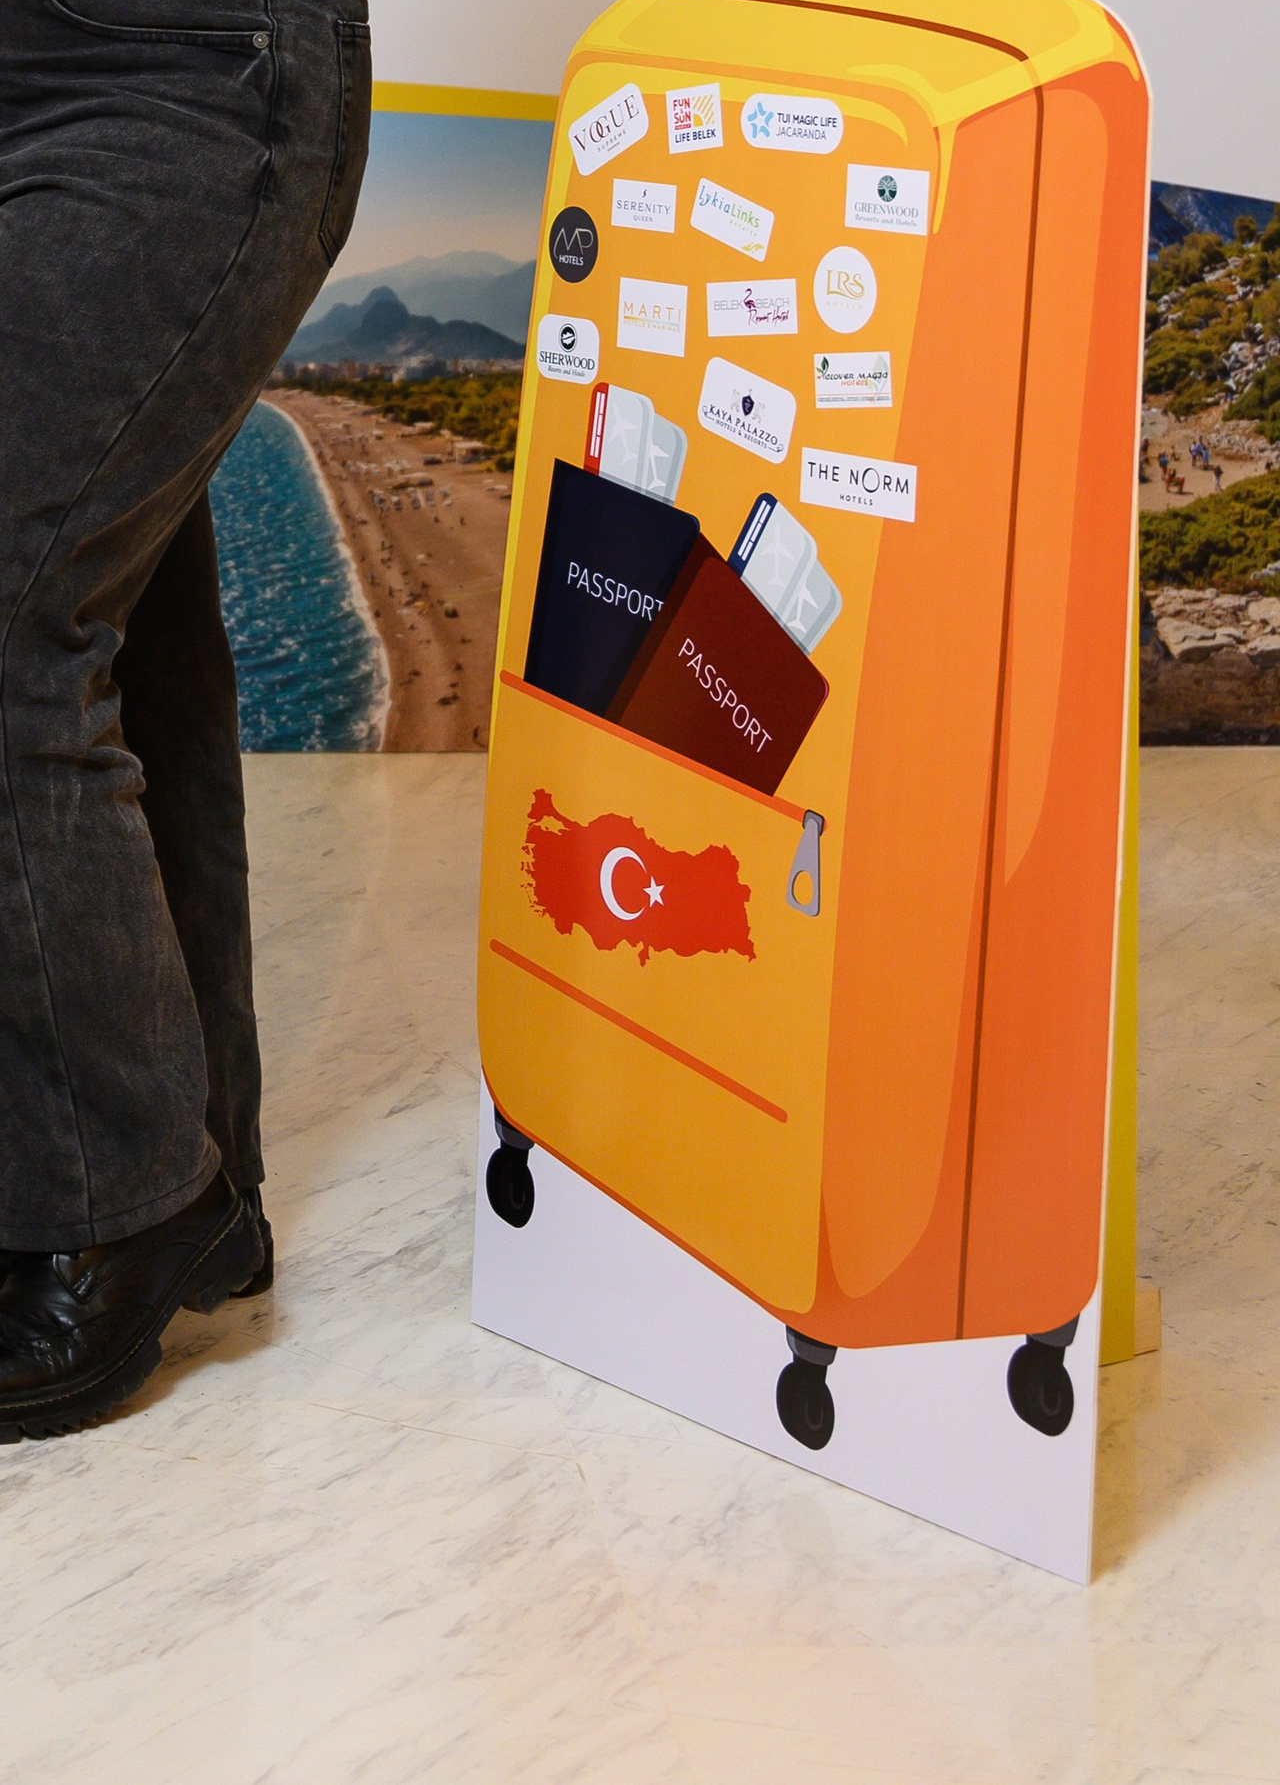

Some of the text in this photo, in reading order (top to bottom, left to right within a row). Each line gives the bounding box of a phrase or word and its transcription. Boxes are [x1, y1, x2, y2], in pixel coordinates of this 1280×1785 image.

[673, 98, 690, 111] FUN
[574, 94, 640, 152] VOGUE
[674, 111, 691, 124] SUN
[777, 112, 838, 128] TUI MAGIC LIFE
[597, 129, 626, 153] SUPREME
[675, 128, 716, 143] LIFE BELEK
[776, 126, 827, 141] JACARANDA
[616, 199, 671, 215] SERENITY
[854, 201, 919, 218] GREENWOOD
[558, 254, 585, 267] HOTELS
[825, 269, 865, 300] LRS
[623, 300, 682, 322] MARTI
[713, 297, 790, 311] BELEK BEACH
[539, 350, 596, 371] SHERWOOD
[709, 404, 778, 446] KAYA PALAZZO
[807, 461, 909, 495] THE NORM
[839, 494, 874, 506] HOTELS
[567, 561, 665, 622] PASSPORT
[678, 637, 773, 753] PASSPORT
